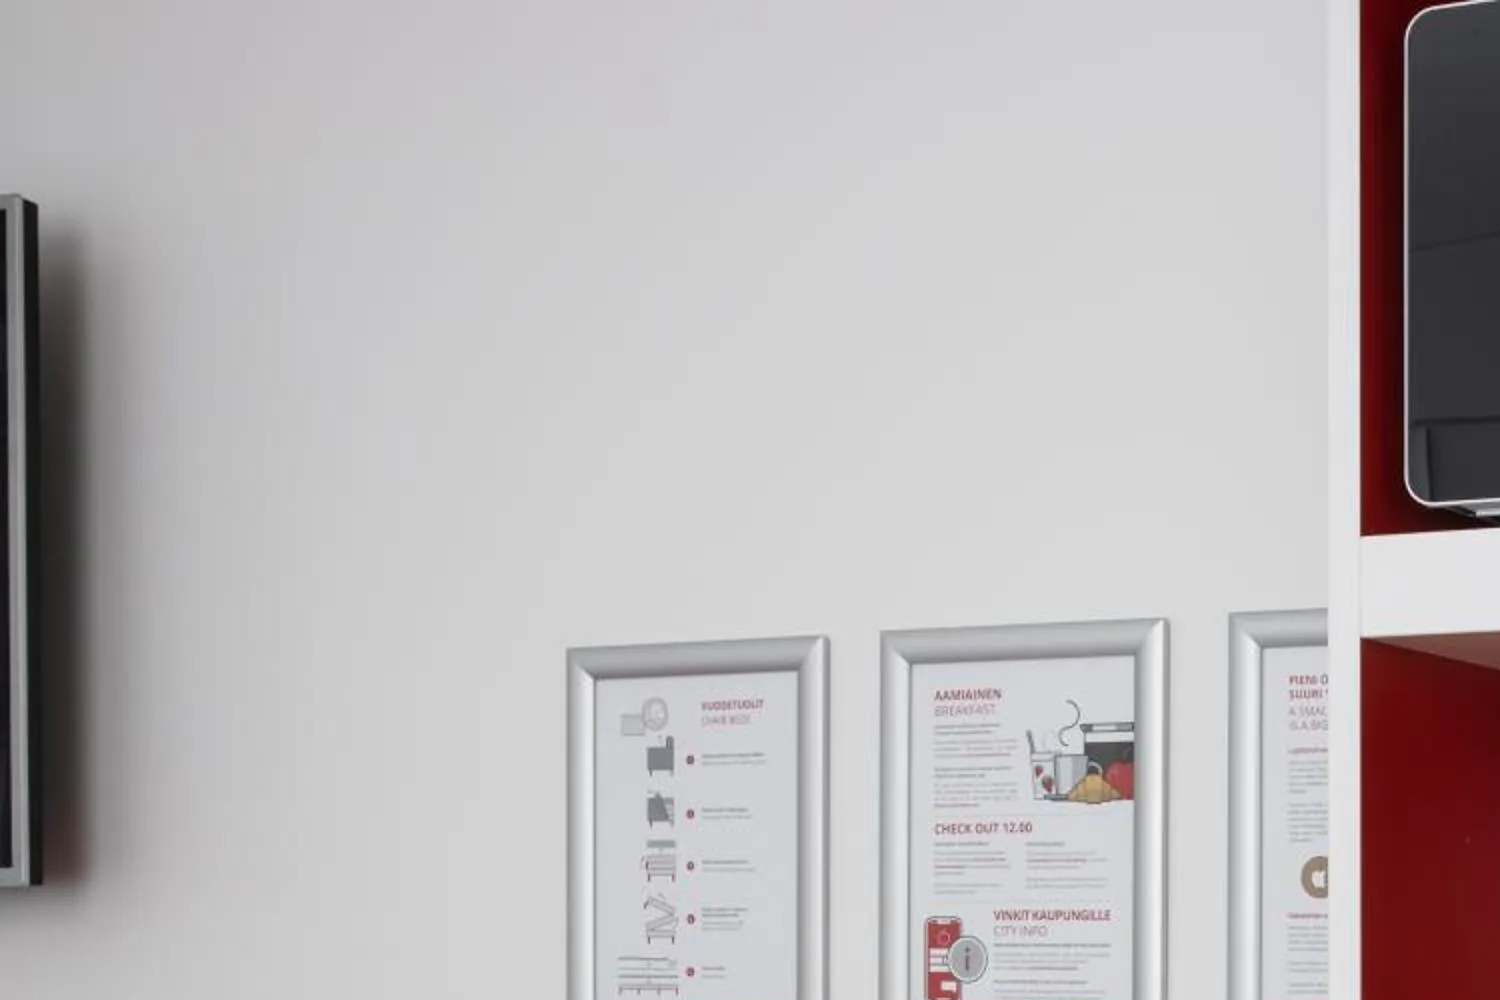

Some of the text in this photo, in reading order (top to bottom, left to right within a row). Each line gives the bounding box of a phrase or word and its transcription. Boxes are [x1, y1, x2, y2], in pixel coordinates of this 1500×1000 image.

[934, 688, 1002, 701] AAMIAINEN
[934, 823, 972, 835] CHECK
[975, 822, 998, 834] OUT
[993, 909, 1030, 921] VINKIT
